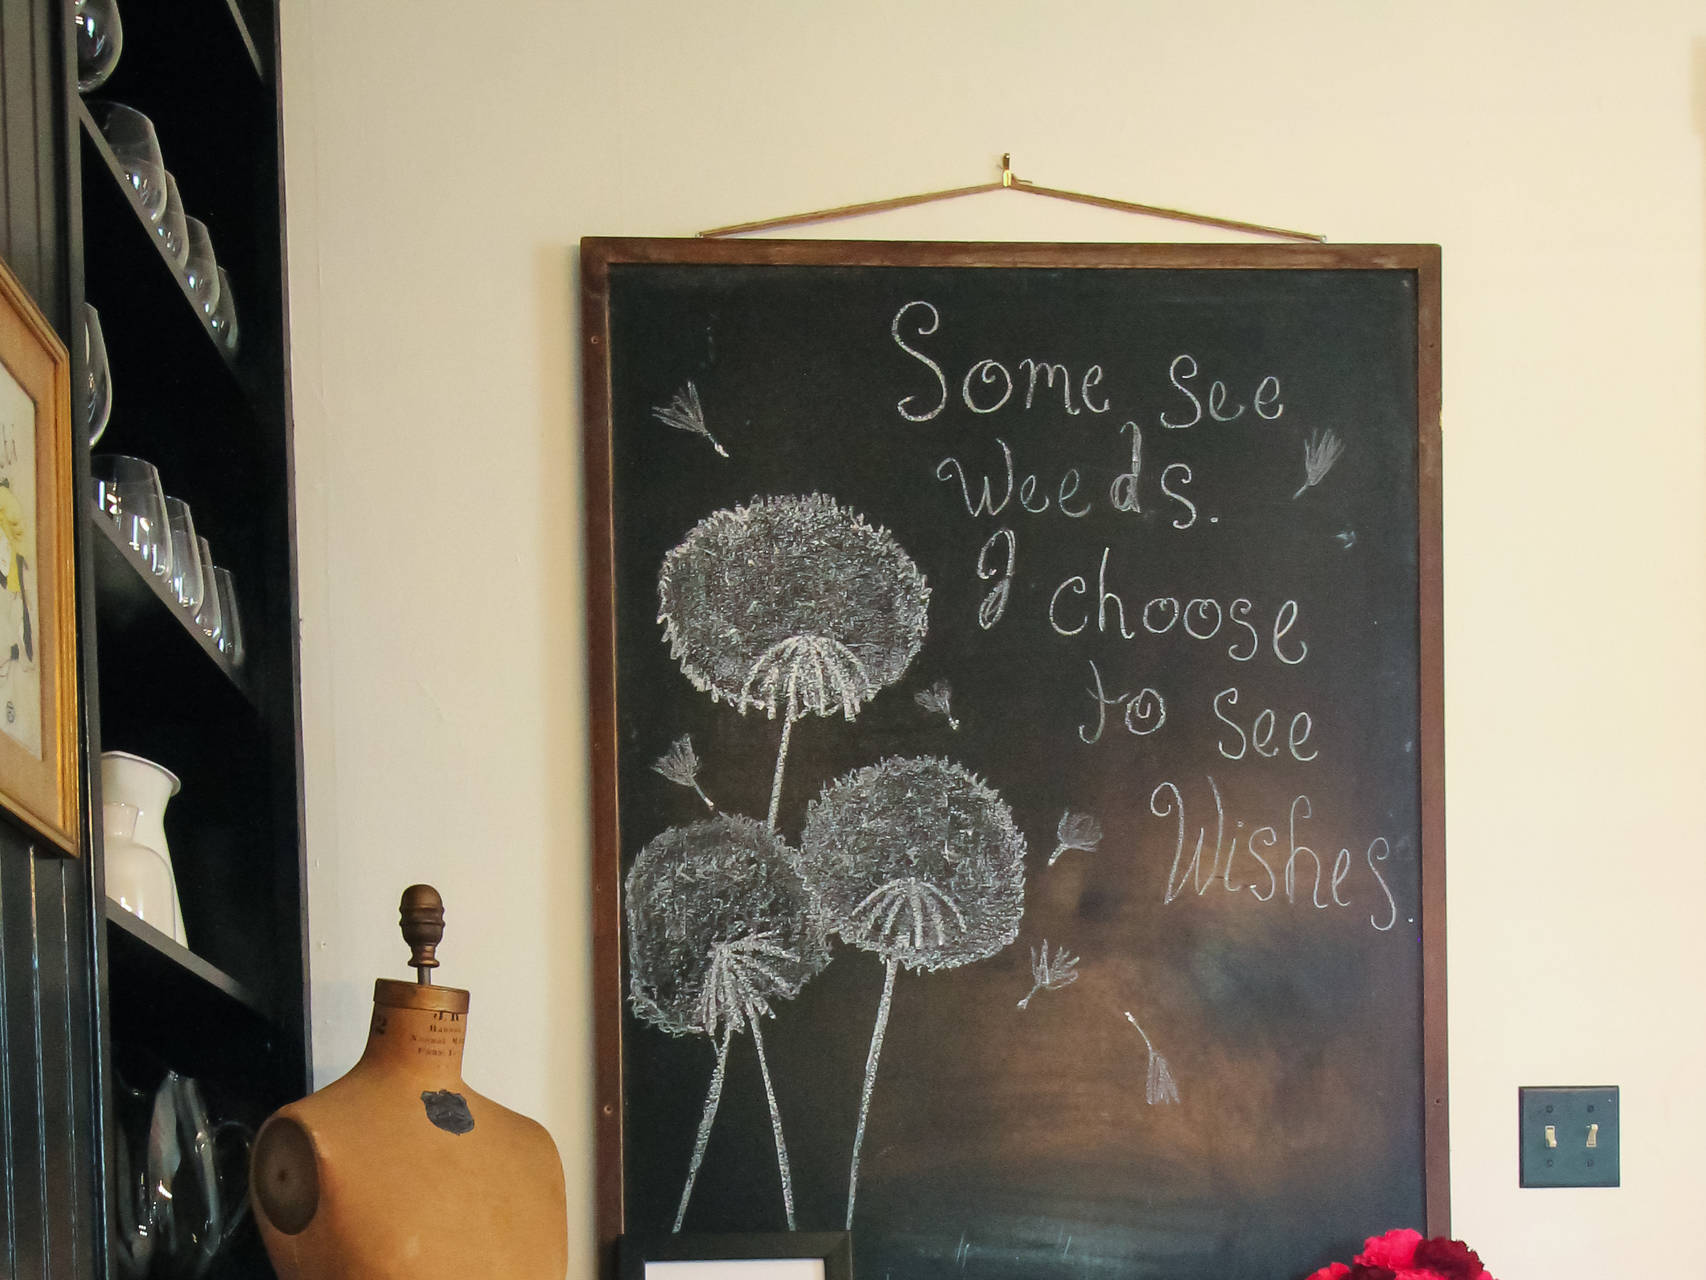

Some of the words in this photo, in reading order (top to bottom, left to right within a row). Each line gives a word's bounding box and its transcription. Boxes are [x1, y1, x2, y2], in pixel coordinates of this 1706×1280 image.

[891, 300, 1110, 423] Some
[1160, 354, 1285, 429] See
[1213, 686, 1319, 762] See
[1150, 775, 1397, 931] Wishes
